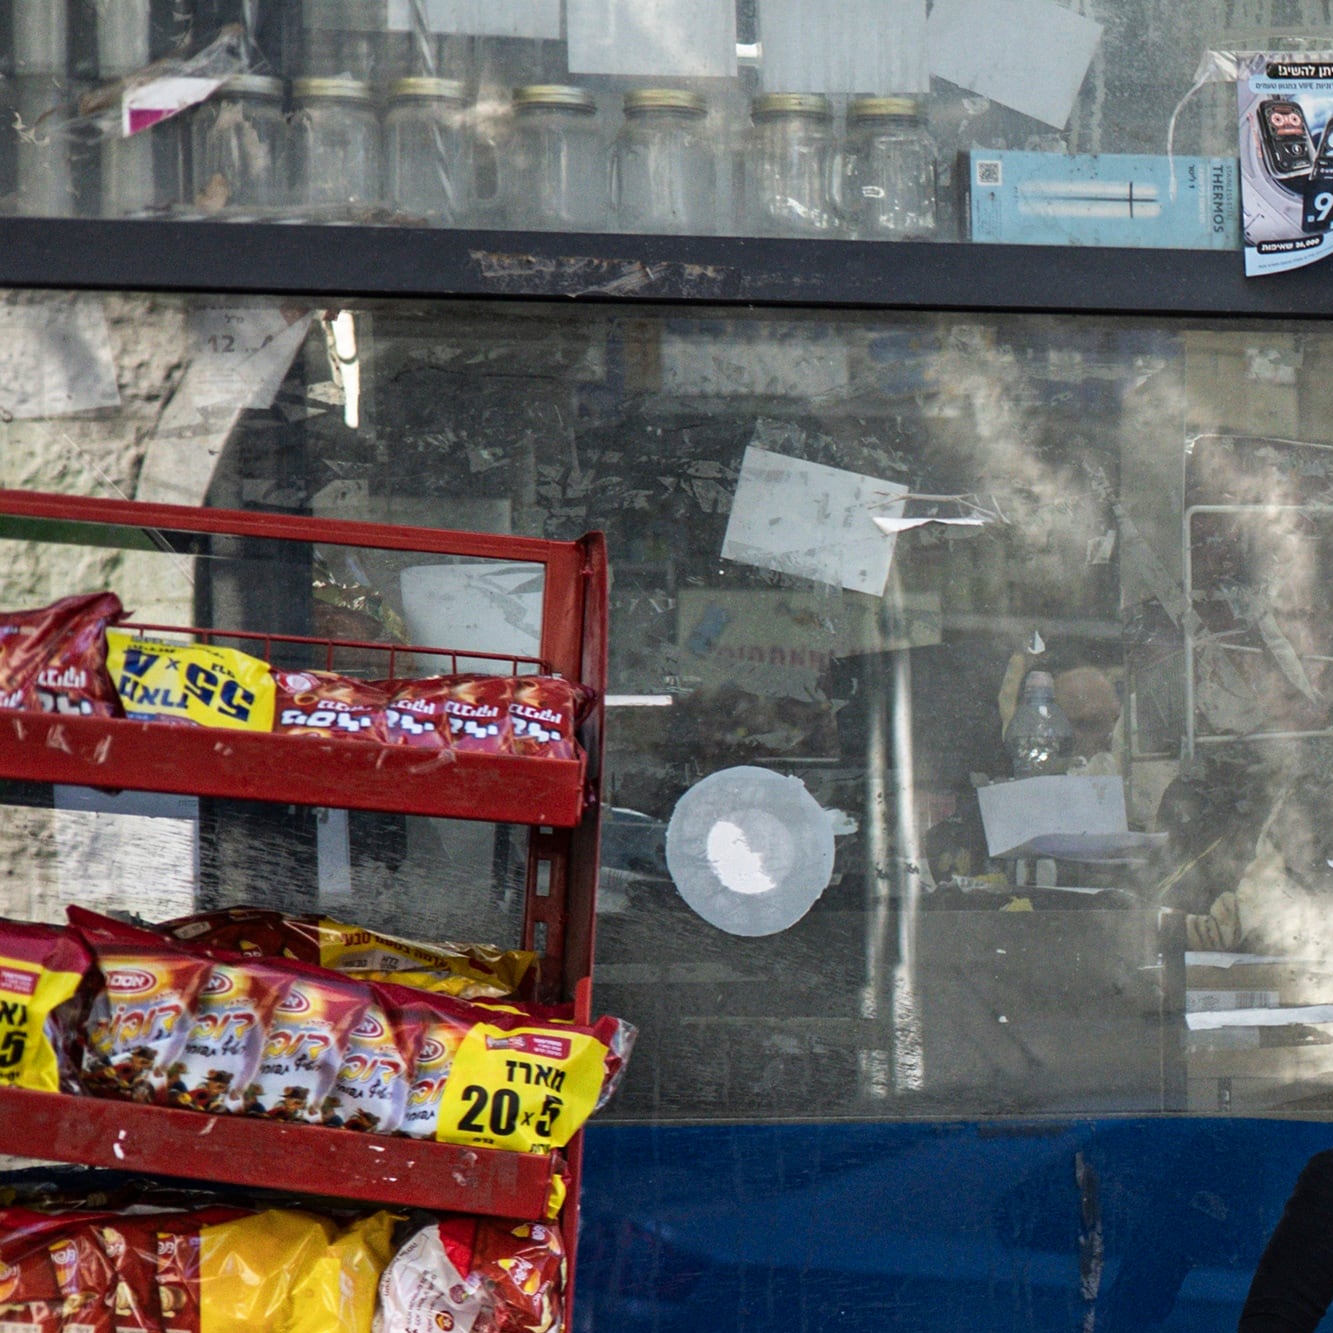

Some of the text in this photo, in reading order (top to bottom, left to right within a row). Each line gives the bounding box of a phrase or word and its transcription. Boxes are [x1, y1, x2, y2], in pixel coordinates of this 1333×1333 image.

[1278, 64, 1316, 77] להשיג!
[1213, 164, 1224, 233] THERMOS
[184, 662, 255, 722] 55
[506, 1060, 567, 1092] מארז
[458, 1085, 520, 1136] 20
